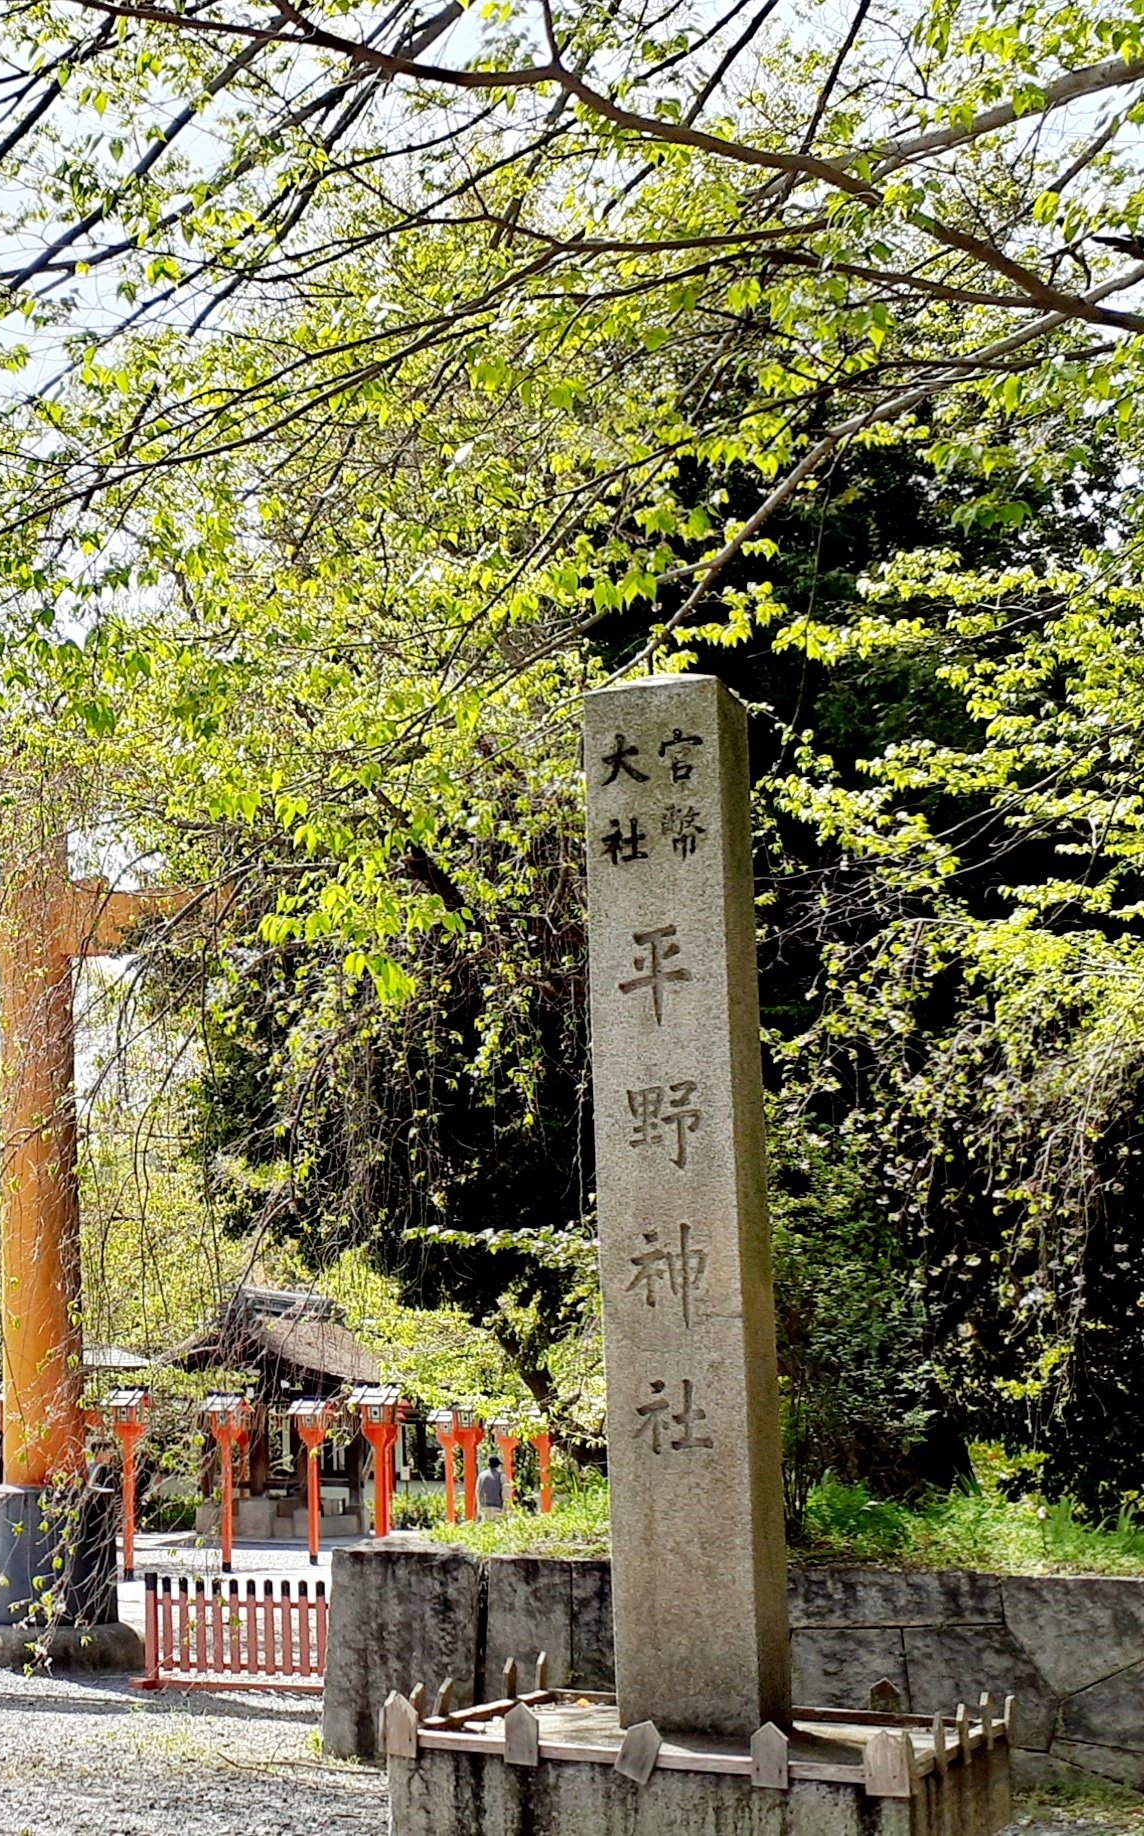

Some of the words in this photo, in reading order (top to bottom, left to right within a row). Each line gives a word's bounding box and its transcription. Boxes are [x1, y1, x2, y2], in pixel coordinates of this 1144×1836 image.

[600, 733, 650, 865] 大社
[618, 923, 714, 1455] 平野神社
